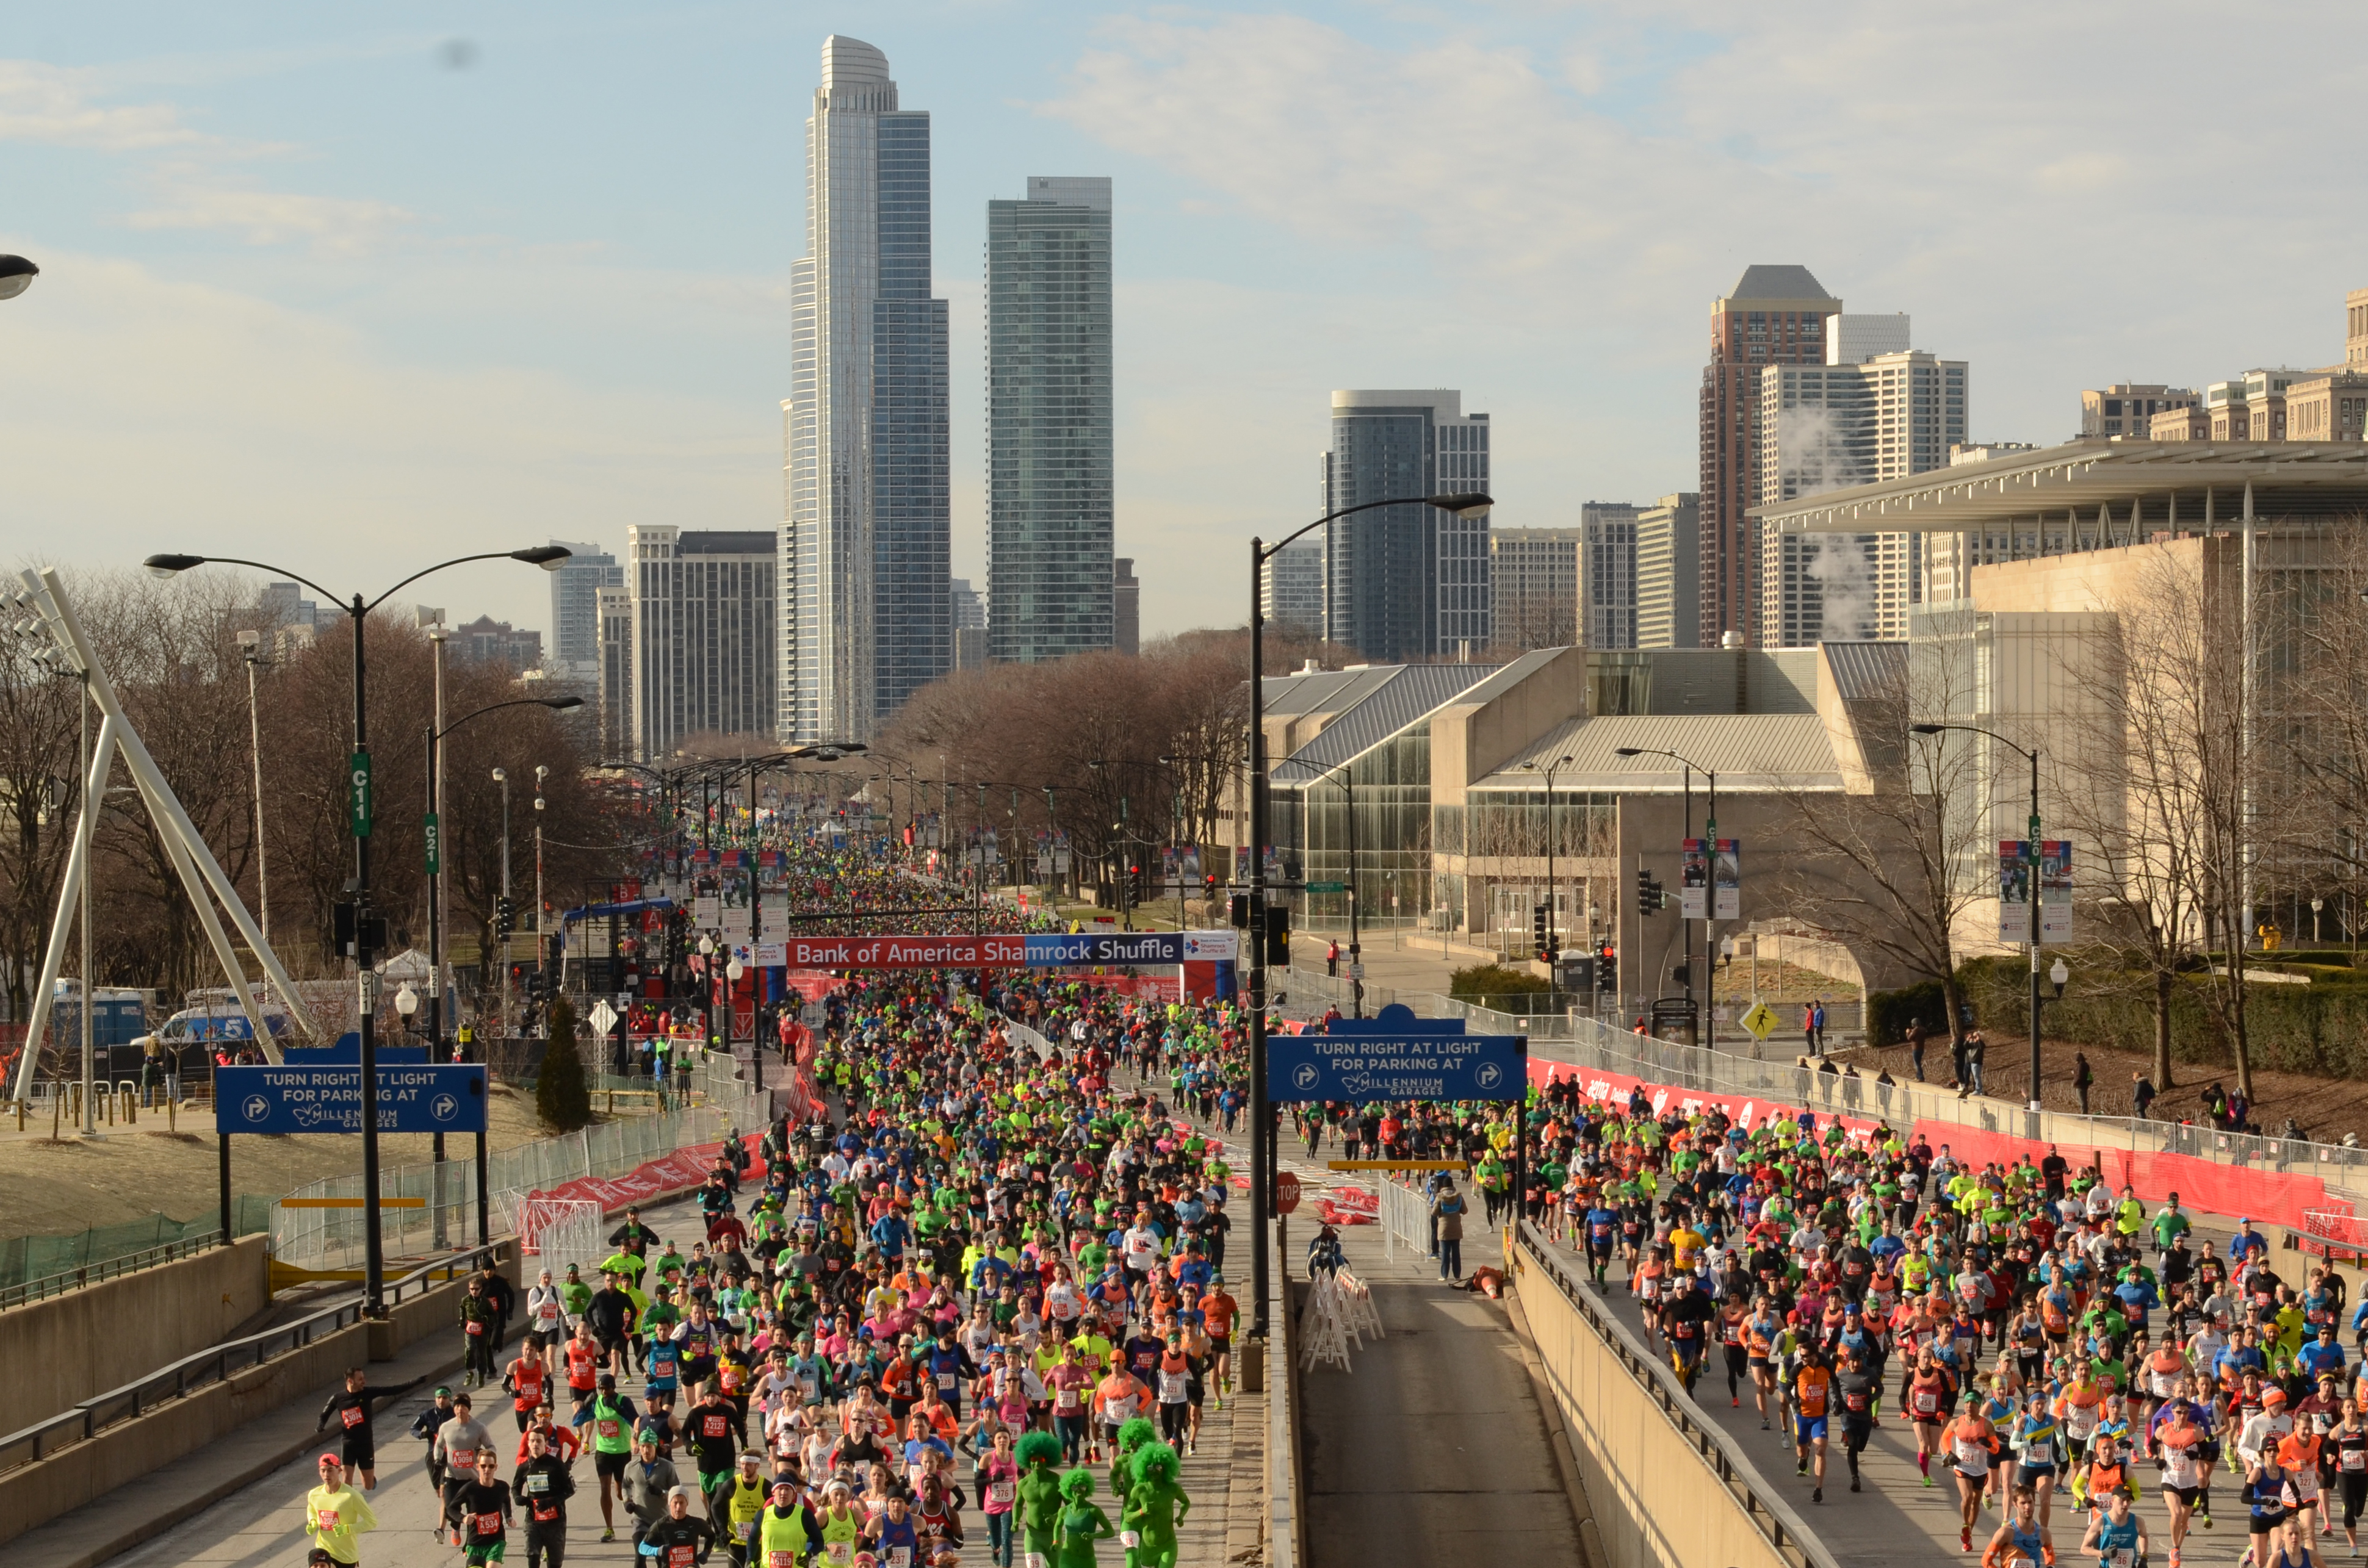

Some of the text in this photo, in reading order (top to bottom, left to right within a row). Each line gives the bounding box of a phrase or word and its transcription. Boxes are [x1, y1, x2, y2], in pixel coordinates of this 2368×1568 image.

[425, 825, 436, 861] C21
[648, 912, 658, 924] A
[796, 939, 1174, 963] Bank of America Shamrock Shuffle
[361, 973, 370, 1011] C11
[1313, 1043, 1481, 1054] TURN RIGHT AT LIGHT
[1332, 1058, 1463, 1070] FOR PARKING AT
[264, 1074, 306, 1085] TURN
[312, 1073, 359, 1085] RIGHT
[391, 1073, 437, 1085] LIGHT
[1361, 1078, 1443, 1087] MILLENNIUM
[1587, 1077, 1611, 1100] aetna
[283, 1089, 418, 1102] FOR PARKG AT
[1277, 1185, 1298, 1201] TOP
[1052, 1293, 1070, 1301] HAWAII
[2173, 1462, 2186, 1471] 226
[890, 1555, 905, 1564] 237
